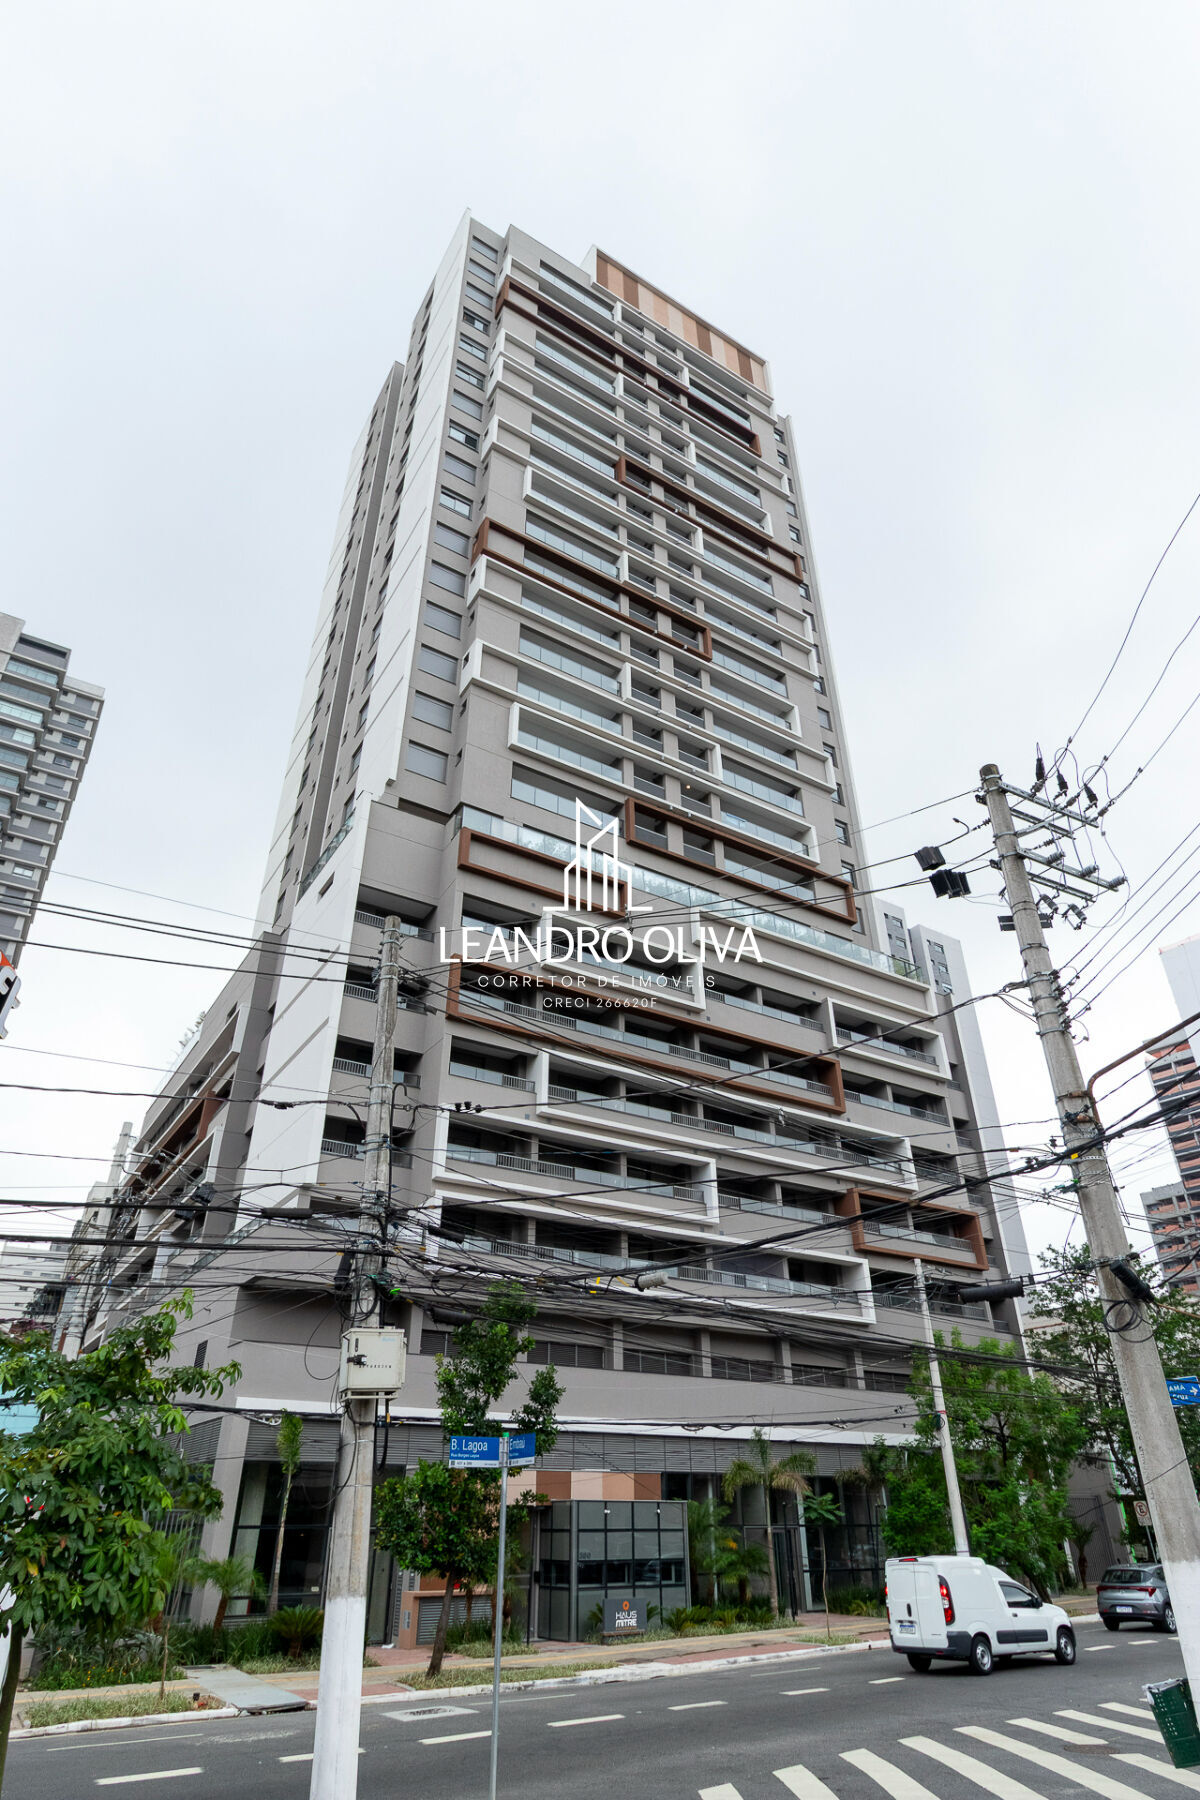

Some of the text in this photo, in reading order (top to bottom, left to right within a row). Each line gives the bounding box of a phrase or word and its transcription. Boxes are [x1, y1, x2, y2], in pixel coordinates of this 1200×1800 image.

[451, 1438, 488, 1453] B. Lagoa
[615, 1611, 637, 1619] HAUS
[615, 1619, 637, 1627] MITRE
